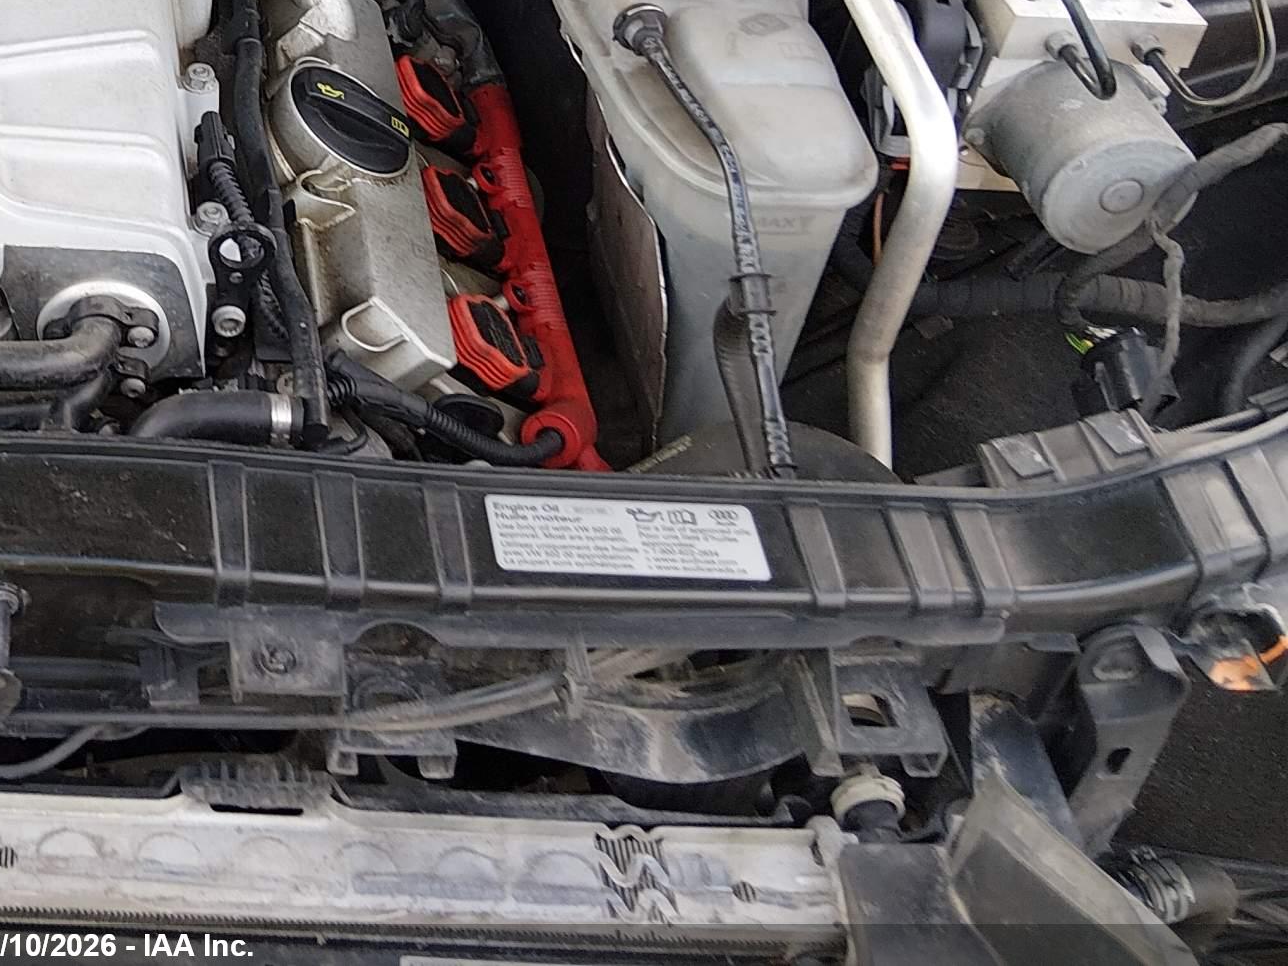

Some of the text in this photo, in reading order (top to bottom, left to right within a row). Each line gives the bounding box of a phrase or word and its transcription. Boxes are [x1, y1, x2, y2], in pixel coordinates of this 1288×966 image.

[492, 502, 538, 514] Engine
[541, 504, 559, 512] Oil
[494, 512, 583, 522] Huile moteur
